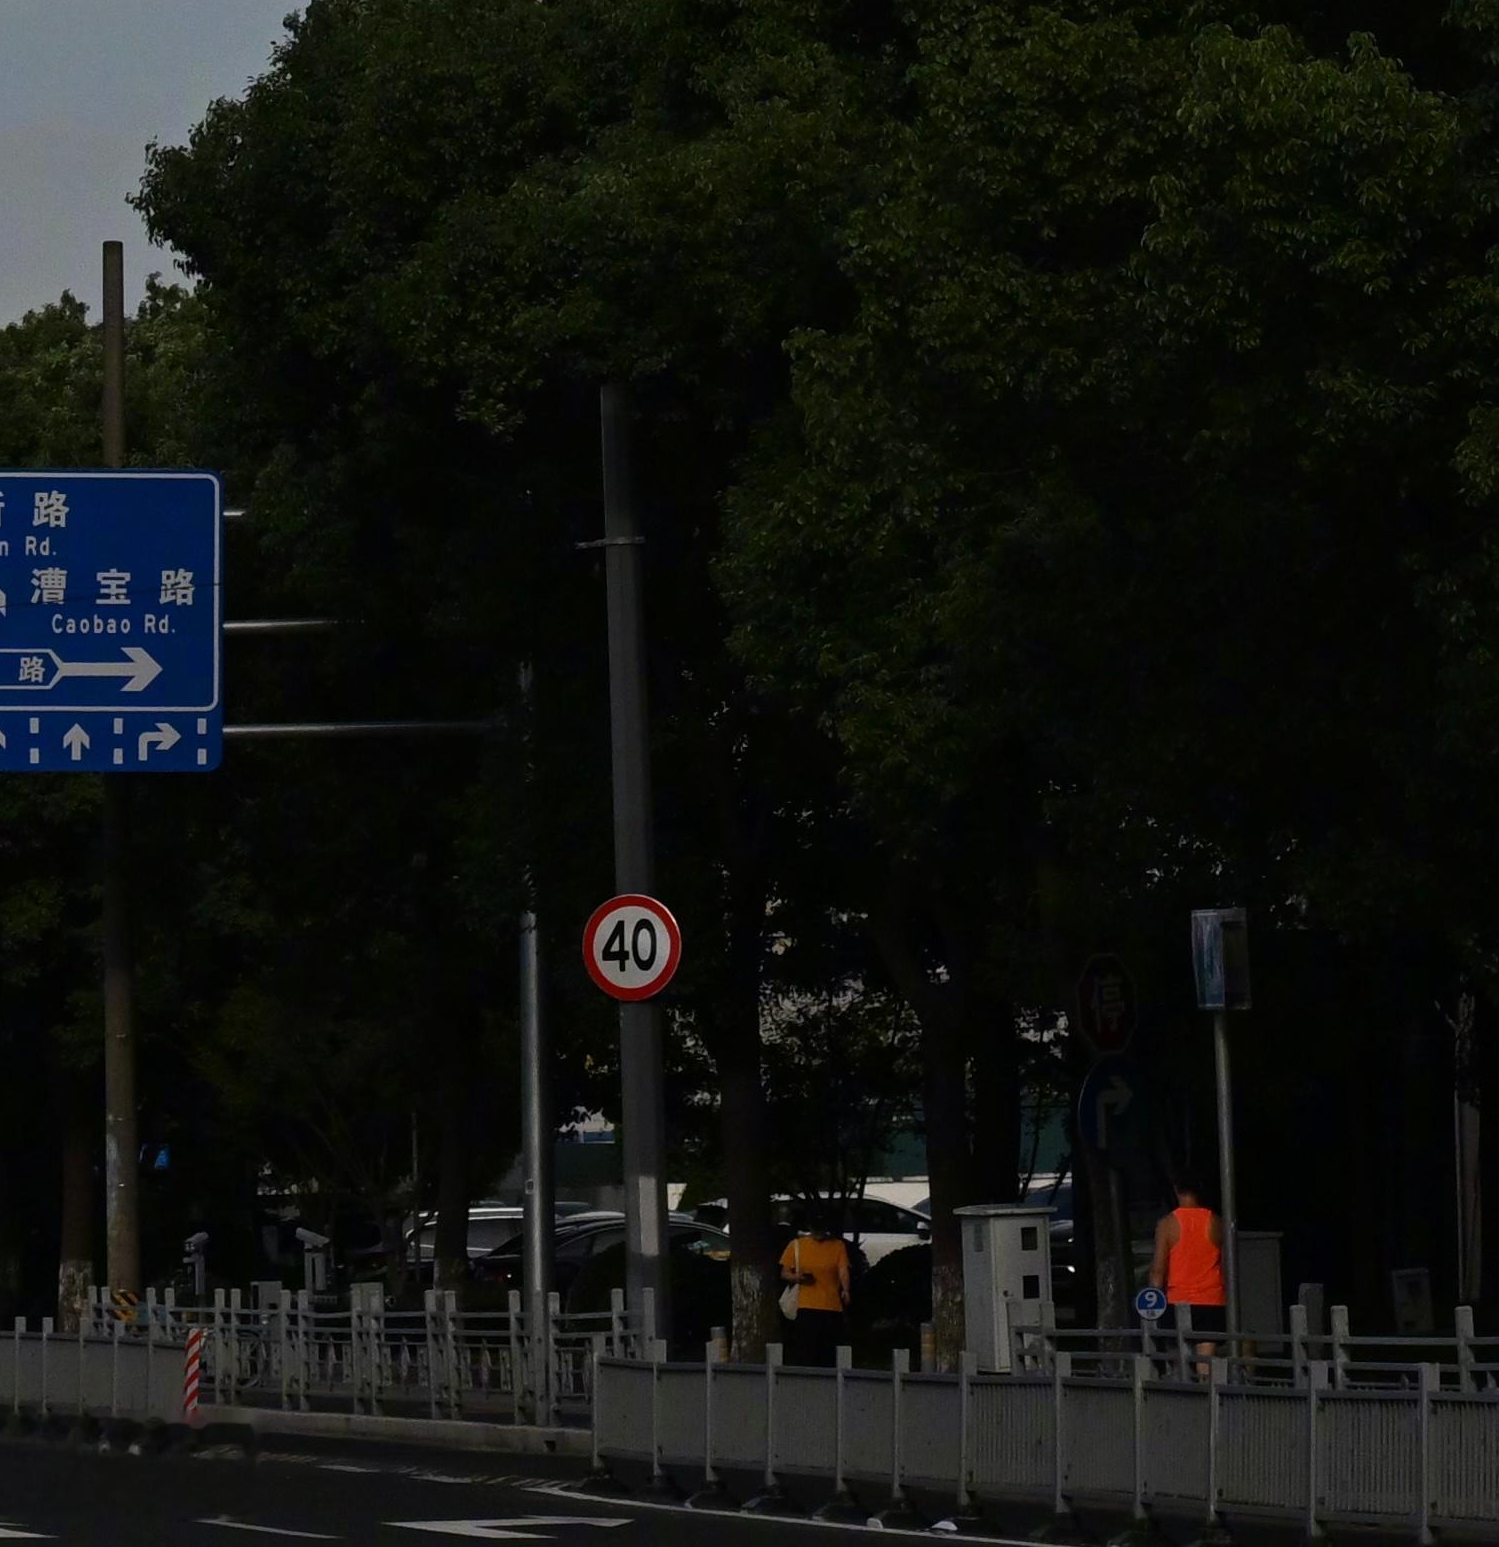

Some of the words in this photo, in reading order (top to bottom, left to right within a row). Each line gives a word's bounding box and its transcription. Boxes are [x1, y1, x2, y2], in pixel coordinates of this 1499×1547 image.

[24, 535, 57, 557] Rd.
[30, 566, 196, 606] 漕宝路
[51, 613, 131, 634] Caobao
[144, 613, 176, 634] Rd.
[602, 918, 657, 972] 40
[1144, 1291, 1158, 1308] 9
